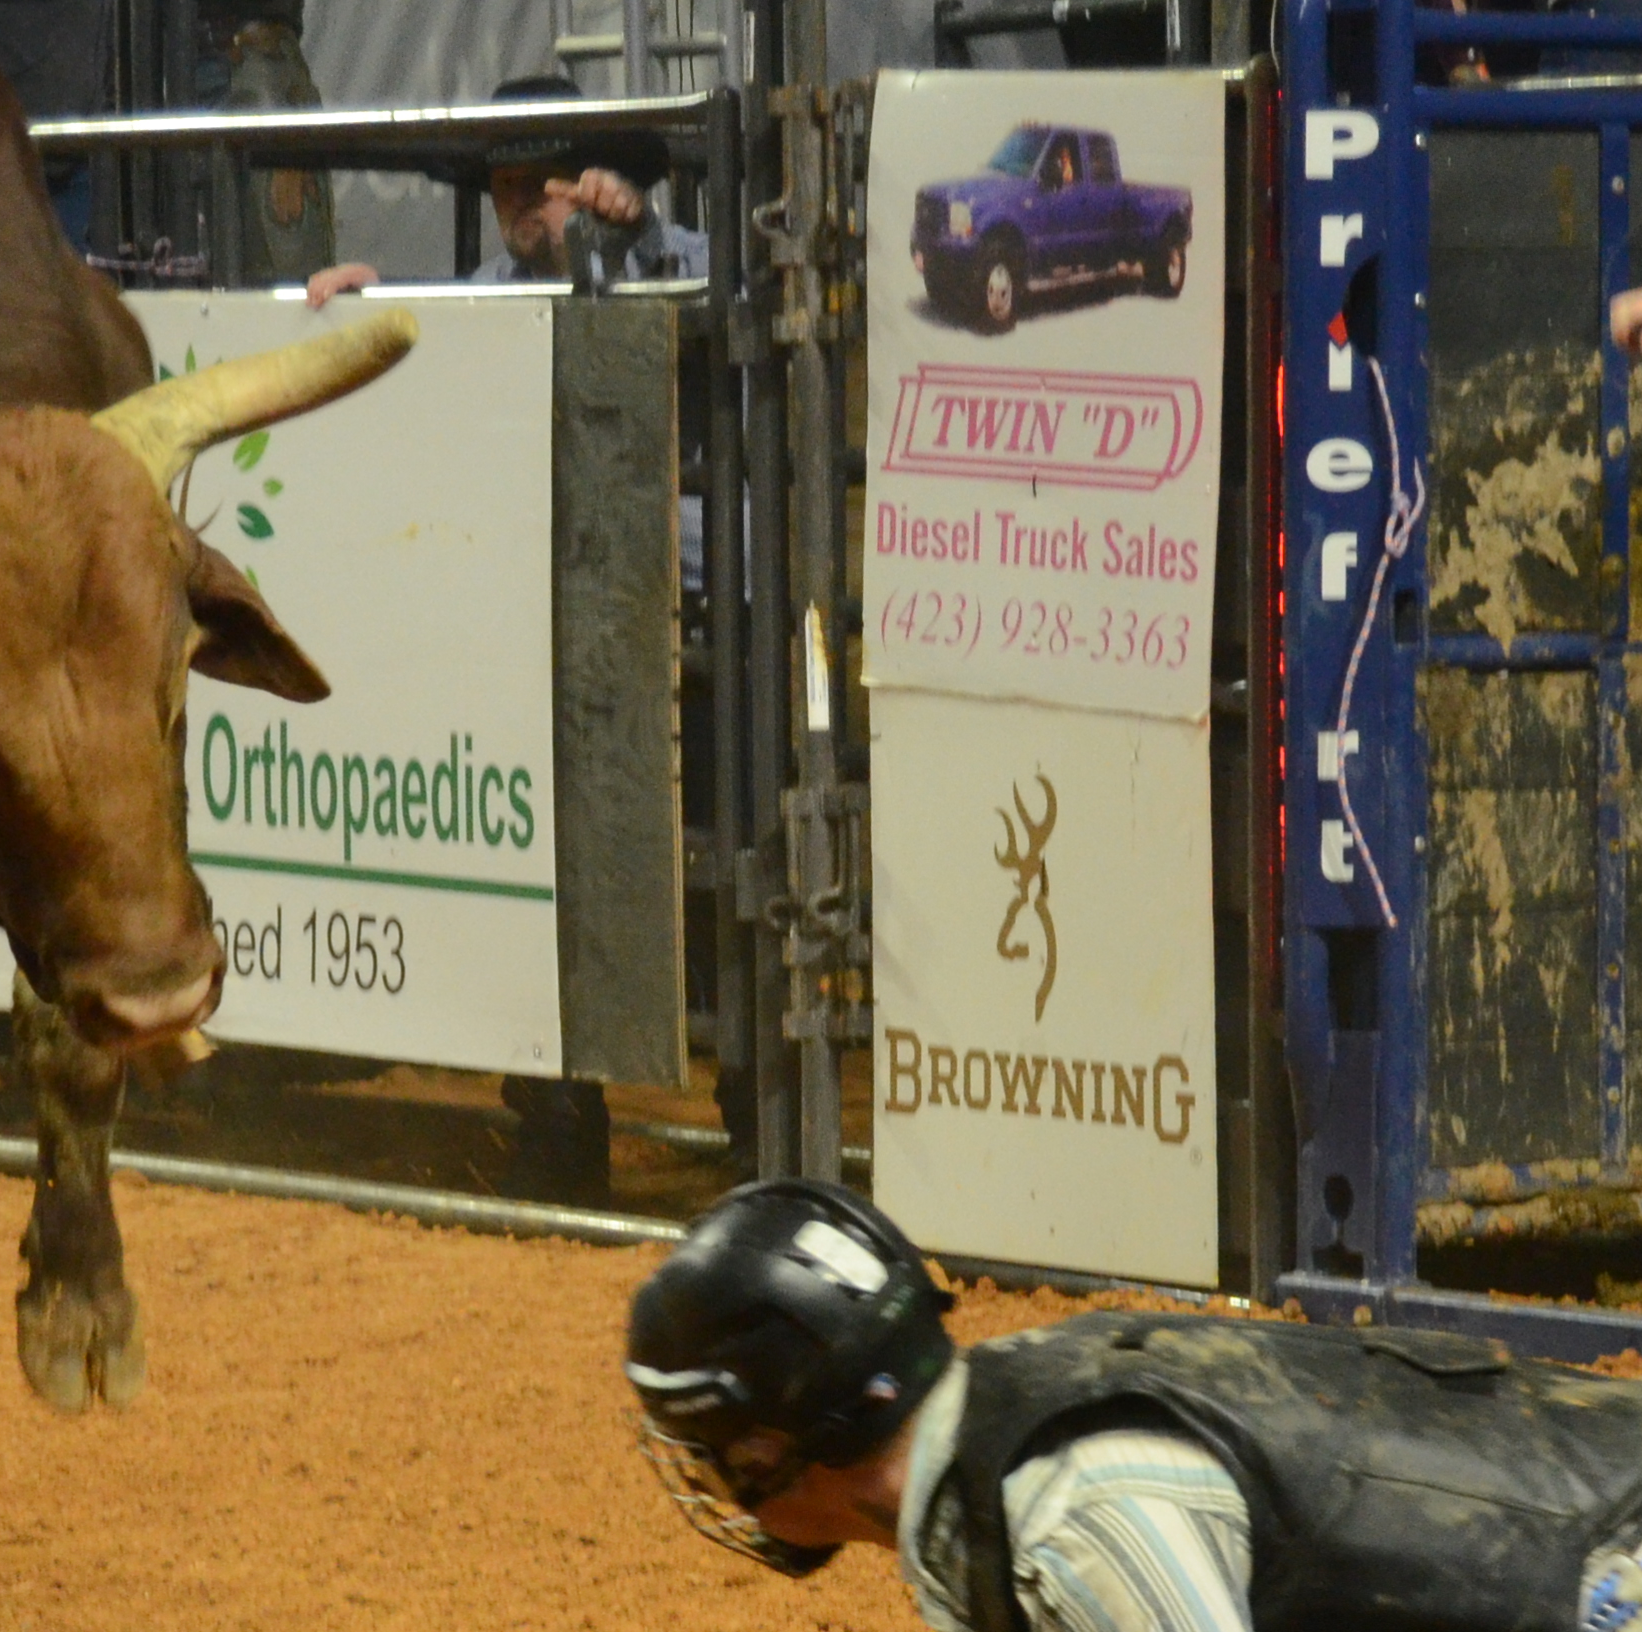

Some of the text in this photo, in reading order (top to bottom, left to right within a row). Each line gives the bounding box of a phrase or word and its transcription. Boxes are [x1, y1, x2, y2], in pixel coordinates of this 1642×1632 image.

[931, 394, 1066, 455] TWIN
[876, 502, 1198, 583] Diesel Truck Sales
[880, 588, 1190, 670] (423) 928-3363
[202, 712, 535, 865] Orthopaedics
[302, 907, 406, 994] 1953
[883, 1026, 1196, 1145] BROWNING
